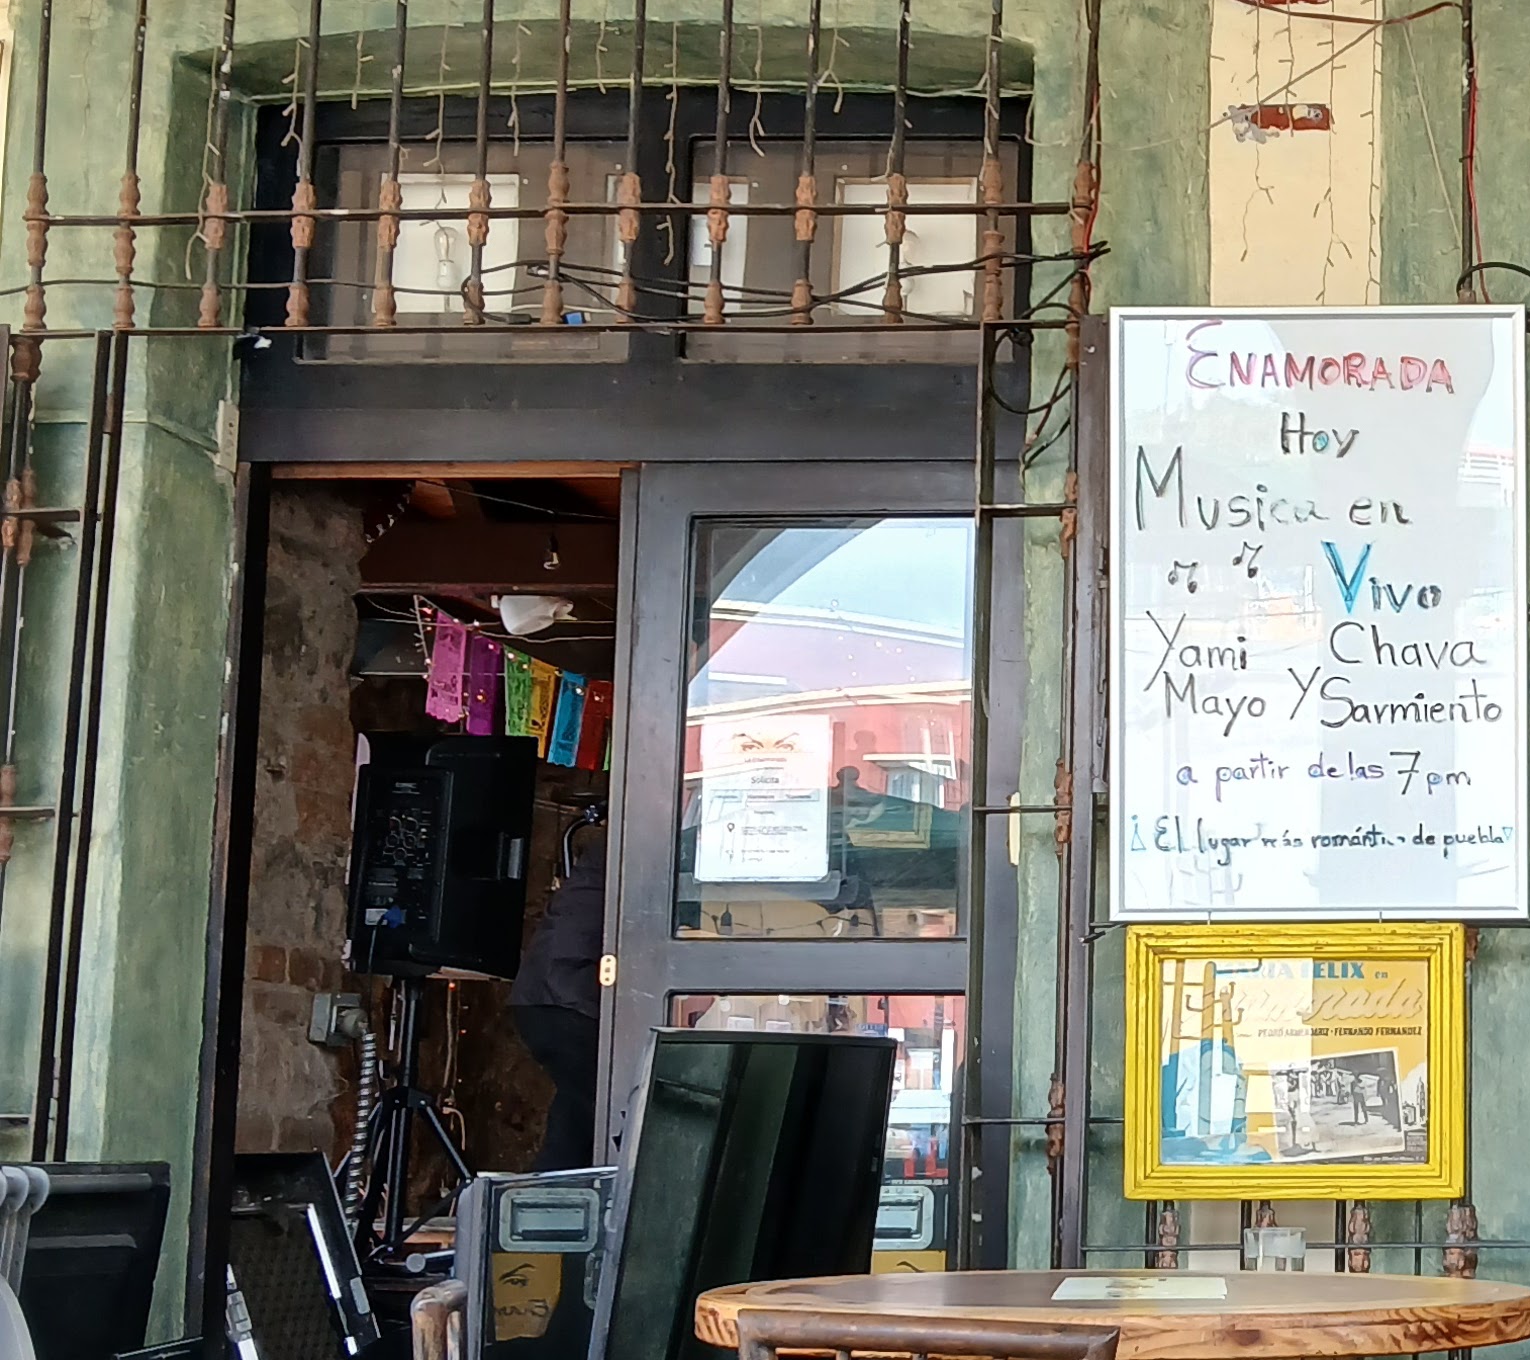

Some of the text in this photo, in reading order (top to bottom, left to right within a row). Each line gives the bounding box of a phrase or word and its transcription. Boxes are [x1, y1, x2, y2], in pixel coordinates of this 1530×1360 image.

[1280, 411, 1360, 458] Hoy
[1348, 496, 1413, 526] en
[1321, 540, 1442, 614] Vivo
[1144, 610, 1487, 691] Yami Chava
[1162, 670, 1266, 737] Mayo
[1320, 676, 1502, 728] Sarmiento
[1177, 764, 1199, 786] a
[1216, 752, 1290, 803] partir
[1197, 818, 1250, 866] lugar
[1412, 822, 1436, 846] de
